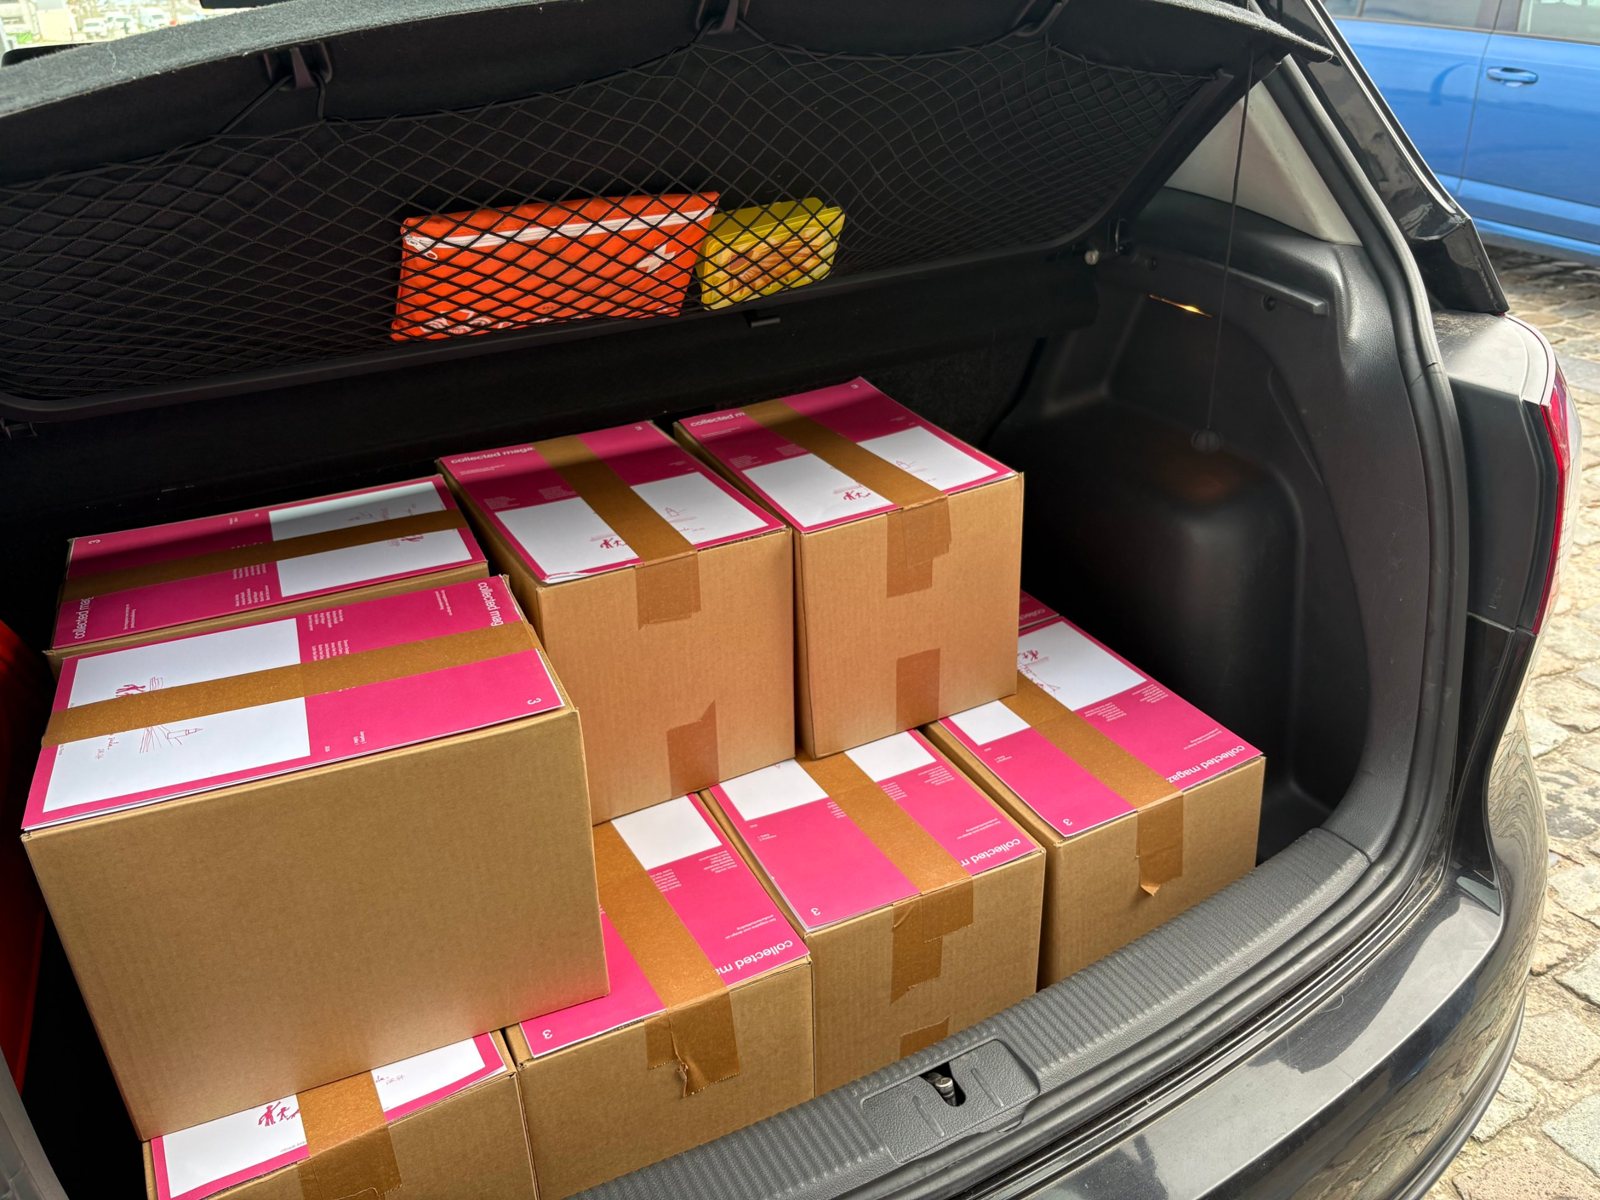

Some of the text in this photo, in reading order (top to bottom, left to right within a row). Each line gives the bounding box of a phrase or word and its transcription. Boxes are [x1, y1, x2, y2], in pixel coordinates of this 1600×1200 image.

[690, 413, 735, 427] collected
[450, 452, 501, 464] collected
[478, 582, 501, 611] collected
[1200, 745, 1245, 770] collected
[1062, 817, 1073, 827] 3
[970, 838, 1021, 864] collected
[810, 906, 821, 917] 3
[734, 939, 793, 970] collected
[542, 1028, 553, 1040] 3
